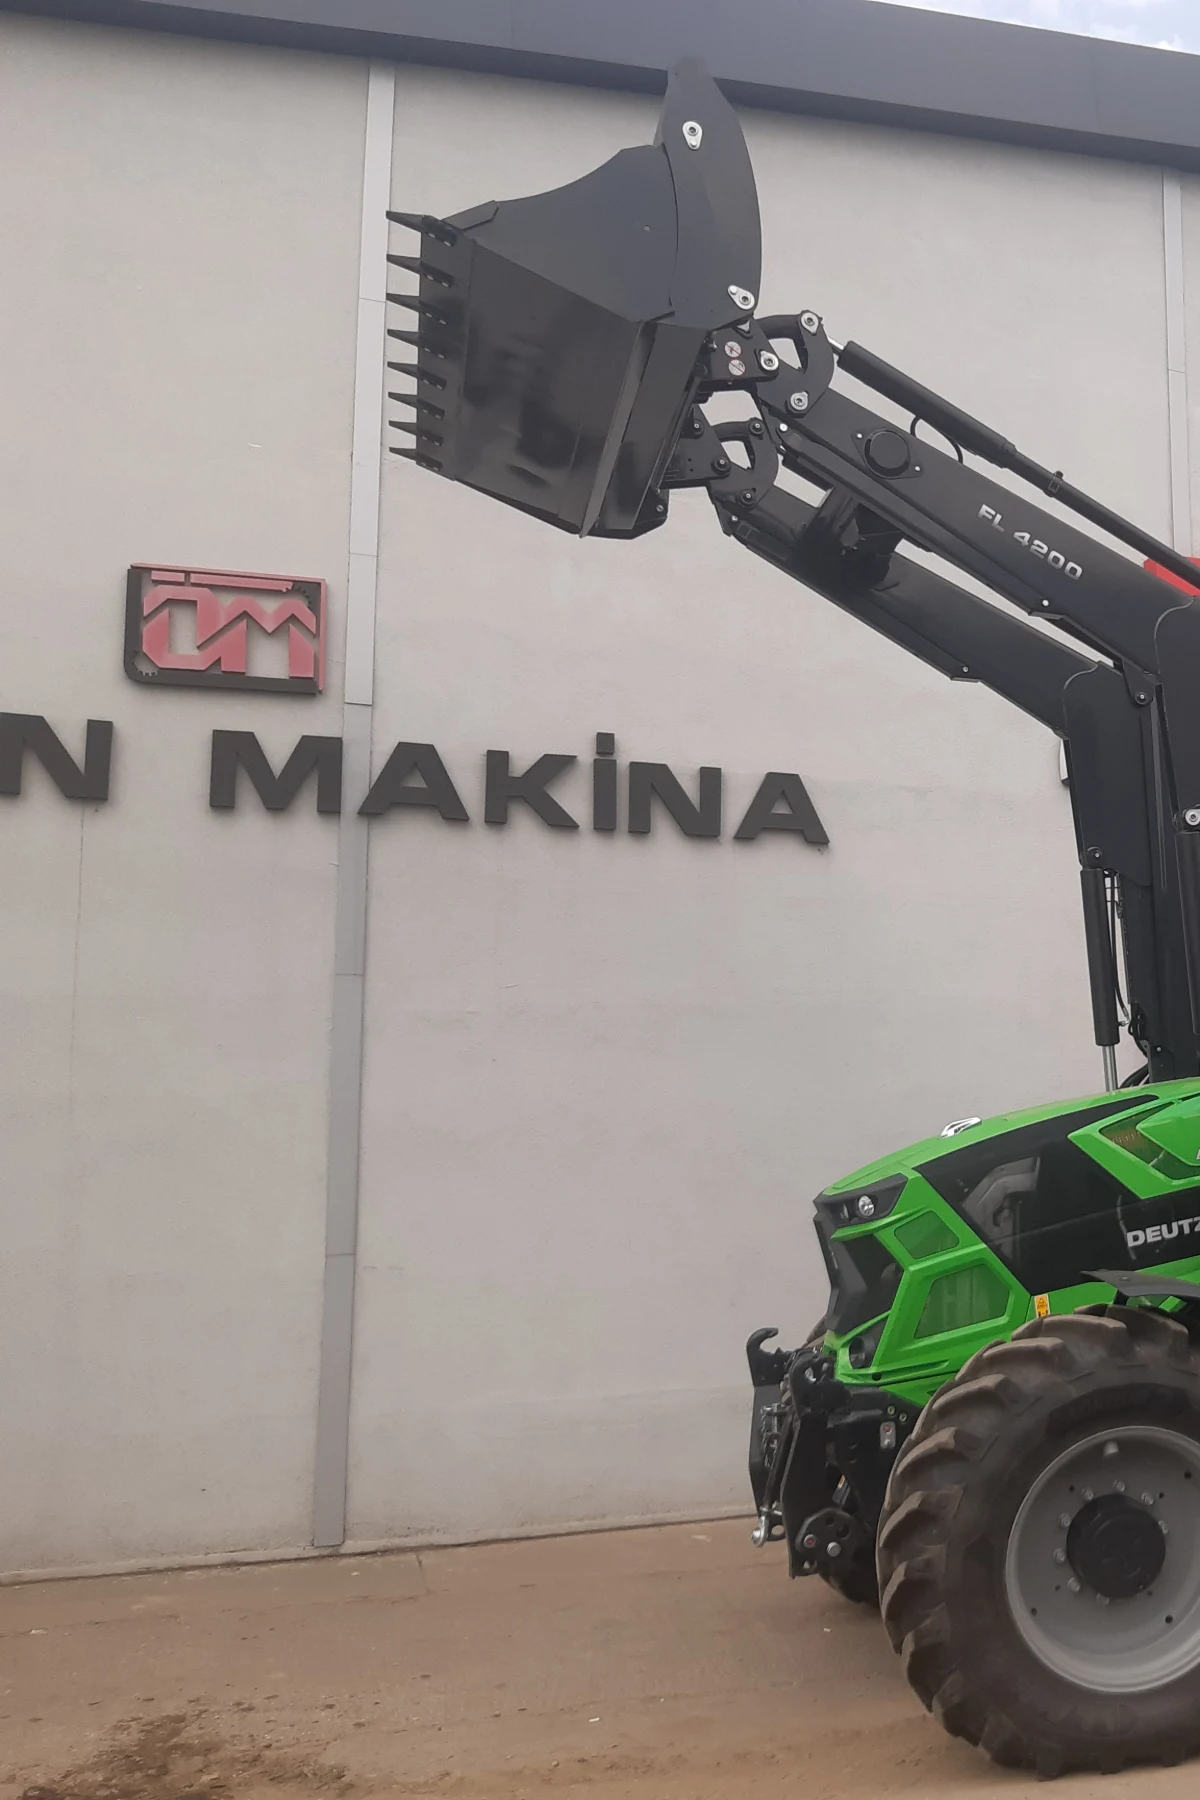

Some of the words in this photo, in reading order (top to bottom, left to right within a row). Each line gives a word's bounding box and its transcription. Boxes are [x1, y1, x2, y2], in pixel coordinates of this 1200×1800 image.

[977, 504, 1005, 532] FL
[1013, 531, 1083, 580] 4200
[209, 729, 830, 844] MAKİNA
